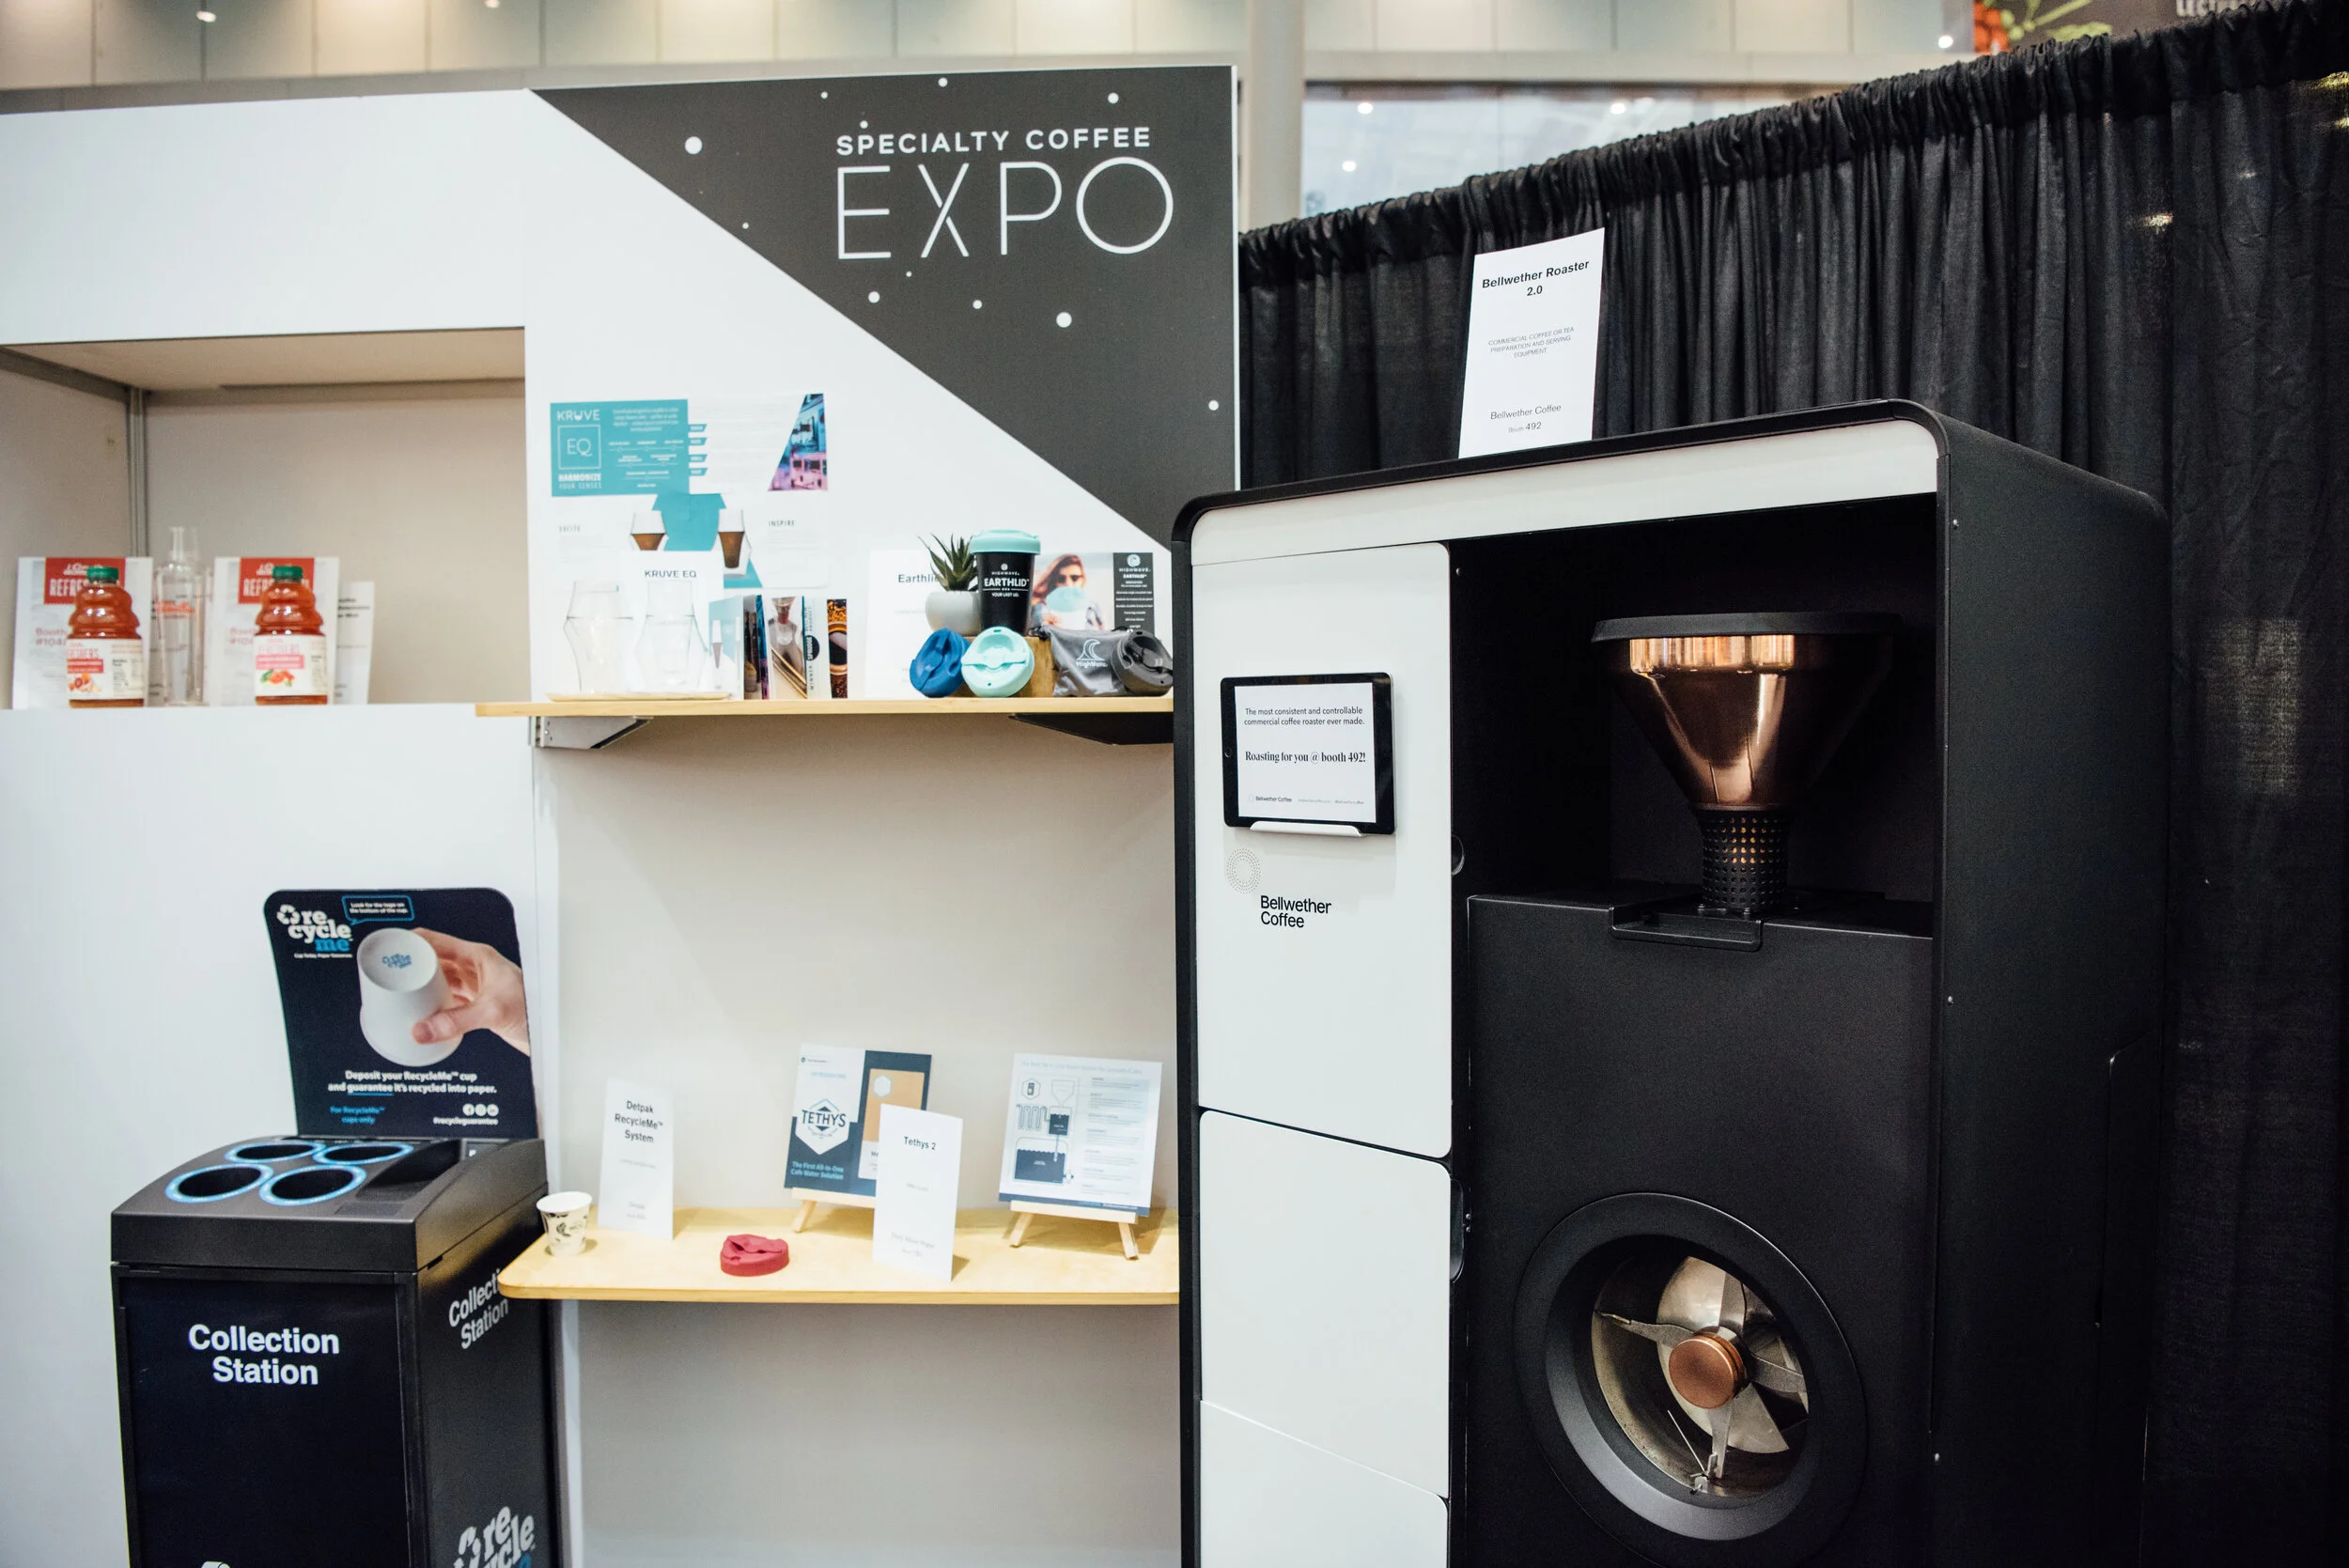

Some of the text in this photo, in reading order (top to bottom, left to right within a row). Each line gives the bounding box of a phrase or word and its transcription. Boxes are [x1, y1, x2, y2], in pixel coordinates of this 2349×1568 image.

[836, 127, 1150, 156] SPECIALTY COFFEE
[837, 156, 1174, 259] EXPO
[1482, 260, 1590, 288] Bellwether Roaster
[1526, 285, 1543, 297] 2.0
[1487, 334, 1528, 346] COMMERCIAL
[1529, 330, 1552, 340] COFFEE
[1490, 342, 1532, 353] PREPARATION
[1546, 335, 1572, 345] SERVING
[1514, 347, 1548, 358] EQUIPMENT
[556, 409, 600, 421] KRUVE
[1490, 404, 1562, 420] Bellwether Coffee
[1525, 421, 1542, 430] 492
[567, 438, 593, 457] EQ
[768, 520, 796, 528] INSPIRE
[645, 569, 697, 579] KRUVE EQ
[898, 573, 938, 583] Earthli
[1245, 707, 1257, 716] The
[1274, 706, 1307, 715] consistent
[1308, 706, 1321, 715] and
[1322, 706, 1363, 715] controllable
[1281, 717, 1301, 725] coffee
[1343, 717, 1365, 725] made.
[1245, 751, 1366, 765] Roasting for you @ booth 492!
[1260, 894, 1332, 914] Bellwether
[301, 909, 328, 925] re
[1260, 910, 1305, 928] Coffee
[288, 919, 351, 944] cycle
[315, 939, 350, 952] me
[344, 1070, 381, 1081] Deposit
[381, 1072, 403, 1082] your
[459, 1073, 477, 1082] cup
[328, 1082, 498, 1094] and guarantee it's recycled into paper.
[626, 1099, 654, 1114] Detpak
[801, 1109, 847, 1127] TETHYS
[625, 1129, 654, 1143] System
[903, 1135, 937, 1150] Tethys 2
[791, 1160, 802, 1169] The
[449, 1267, 500, 1327] Collect
[460, 1298, 508, 1350] Station
[188, 1323, 340, 1355] Collection
[211, 1356, 319, 1386] Station
